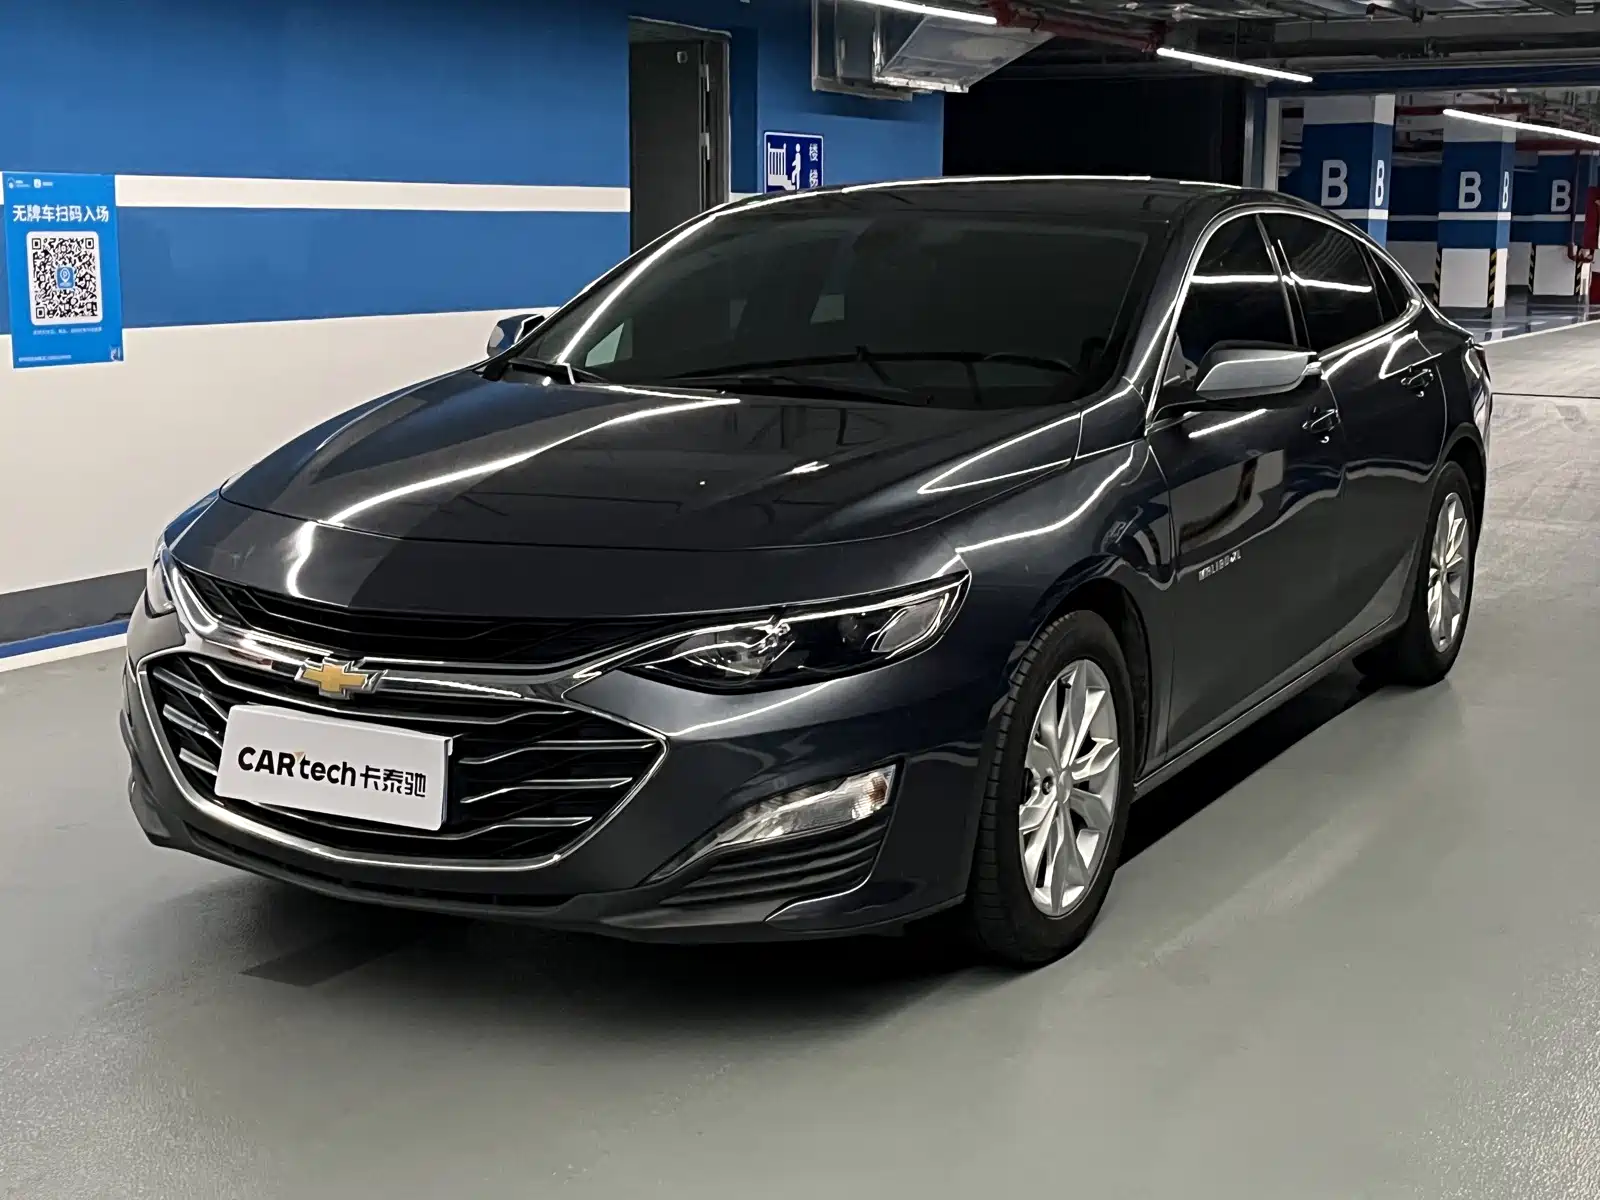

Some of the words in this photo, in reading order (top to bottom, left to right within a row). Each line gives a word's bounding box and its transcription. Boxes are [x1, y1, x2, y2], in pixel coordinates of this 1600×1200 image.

[1321, 159, 1348, 206] B
[1375, 160, 1384, 206] B
[1458, 171, 1482, 209] B
[1502, 171, 1509, 209] B
[1551, 179, 1571, 212] B
[12, 204, 110, 222] 无牌车扫码入场
[360, 765, 426, 797] 卡泰驰
